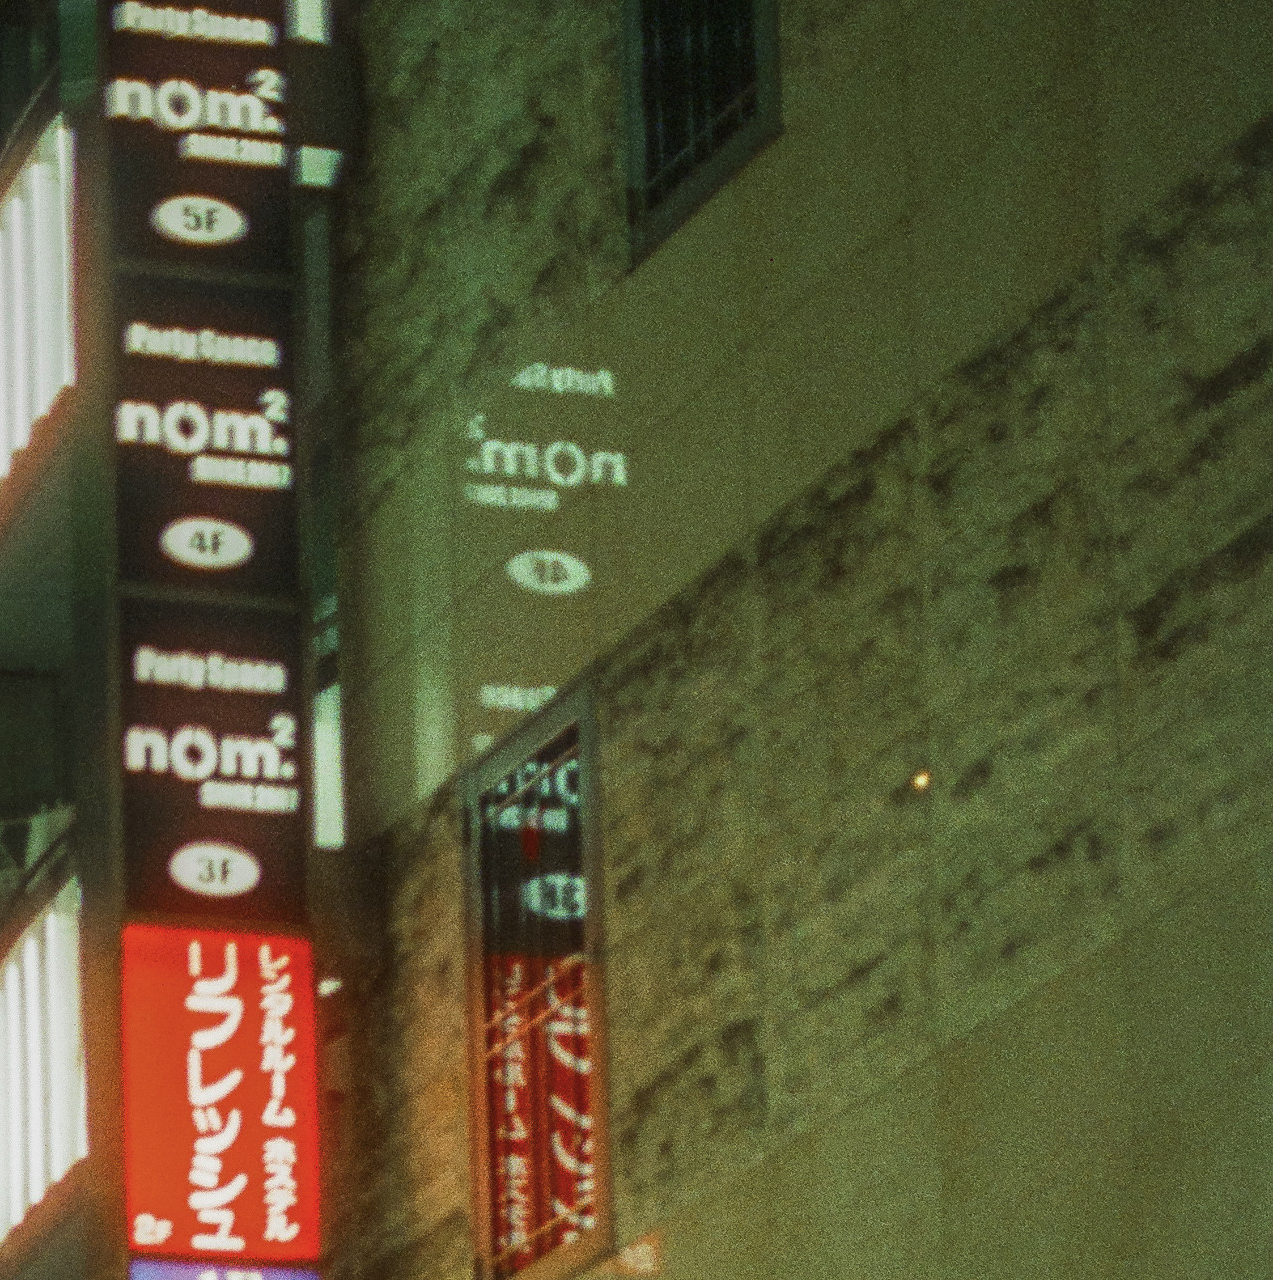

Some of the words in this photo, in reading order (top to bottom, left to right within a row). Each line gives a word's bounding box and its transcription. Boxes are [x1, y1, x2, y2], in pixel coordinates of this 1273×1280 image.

[182, 204, 219, 233] 5F
[189, 531, 224, 555] 4F
[197, 856, 231, 885] 3F
